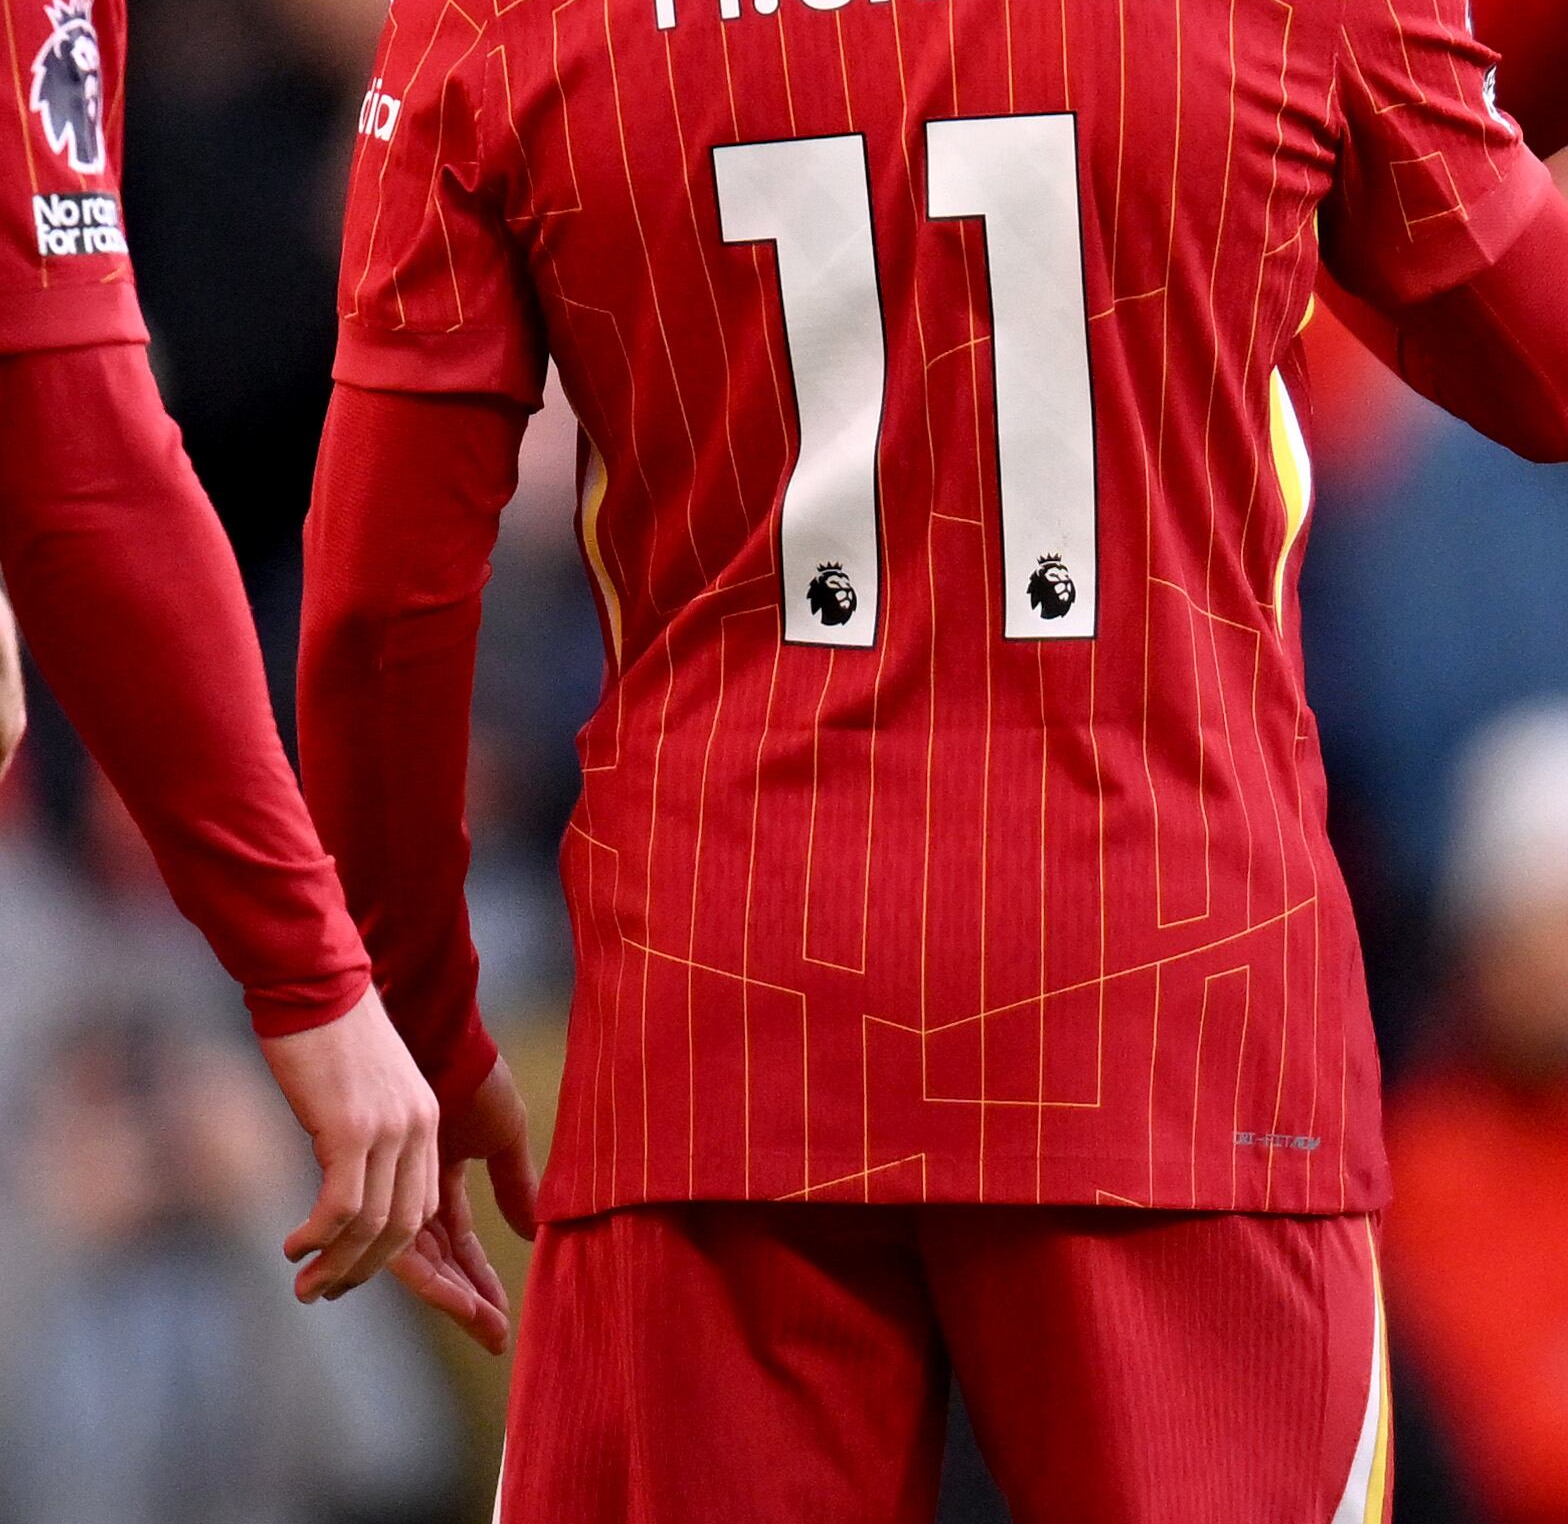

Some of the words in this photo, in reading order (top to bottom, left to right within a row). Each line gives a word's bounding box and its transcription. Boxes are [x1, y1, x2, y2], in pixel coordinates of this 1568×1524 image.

[32, 193, 80, 228] No
[36, 224, 81, 256] for
[711, 111, 1100, 649] 11
